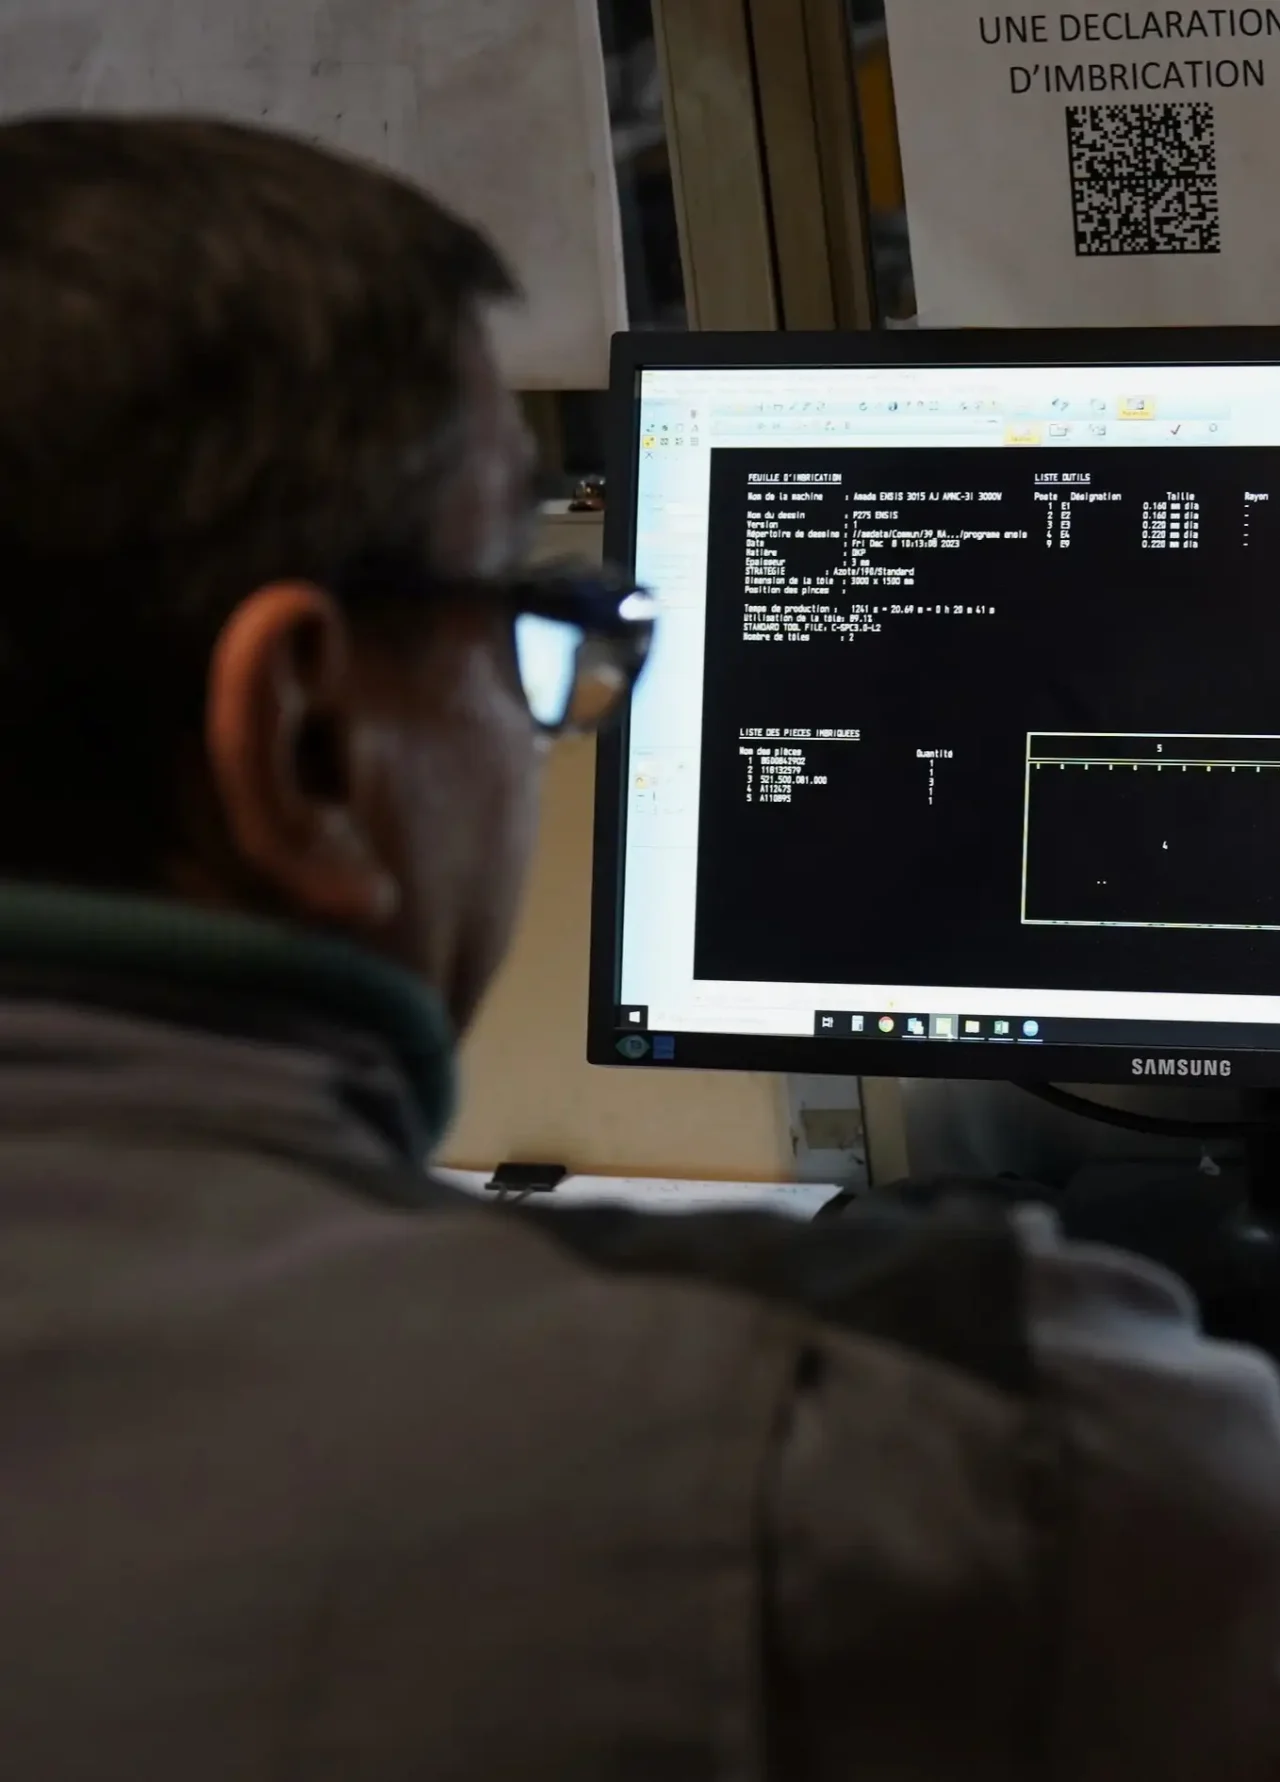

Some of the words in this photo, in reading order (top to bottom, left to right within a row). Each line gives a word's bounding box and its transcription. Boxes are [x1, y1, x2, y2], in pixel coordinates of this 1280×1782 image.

[978, 15, 1048, 45] UNE
[1009, 59, 1265, 94] D'IMBRICATION
[748, 473, 780, 482] FEUILLE
[783, 473, 842, 482] D'IMBRICATION
[1034, 472, 1059, 482] LISTE
[1062, 472, 1091, 482] OUTILS
[747, 492, 762, 501] Nom
[764, 492, 776, 501] de
[779, 492, 788, 501] la
[791, 492, 824, 501] machine
[853, 492, 877, 501] Amada
[879, 491, 904, 501] ENSIS
[906, 491, 926, 501] 3015
[928, 492, 940, 501] AJ
[1034, 491, 1058, 501] Poste
[1166, 491, 1195, 501] Taille
[1244, 491, 1269, 503] Rayon
[1061, 501, 1070, 510] E1
[1142, 501, 1167, 510] 0.160
[746, 510, 762, 520] Nom
[764, 510, 775, 520] du
[777, 510, 806, 520] dessin
[852, 510, 872, 520] P275
[874, 510, 898, 520] ENSIS
[1060, 510, 1072, 520] E2
[1142, 510, 1167, 520] 0.160
[746, 520, 779, 529] Version
[1060, 520, 1071, 530] E3
[1142, 520, 1167, 530] 0.220
[746, 528, 792, 540] Répertoire
[794, 529, 805, 538] de
[807, 529, 840, 539] dessins
[1060, 529, 1070, 539] E4
[1142, 530, 1166, 539] 0.220
[746, 538, 765, 548] Date
[851, 538, 865, 548] Fri
[869, 538, 884, 548] Dec
[940, 539, 960, 548] 2023
[1059, 539, 1070, 548] E9
[1141, 539, 1166, 548] 0.220
[745, 566, 786, 576] STRATEGIE
[744, 576, 786, 585] Dimension
[788, 576, 799, 585] de
[802, 576, 812, 585] la
[850, 576, 870, 585] 3000
[882, 576, 901, 586] 1500
[744, 585, 781, 594] Position
[783, 586, 798, 594] des
[801, 586, 830, 596] pinces
[770, 604, 782, 613] de
[784, 604, 830, 615] production
[743, 613, 794, 622] Utilisation
[796, 614, 807, 623] de
[810, 614, 820, 623] la
[743, 622, 780, 632] STANDARD
[782, 622, 802, 632] TOOL
[804, 623, 827, 632] FILE:
[742, 632, 771, 641] Nombre
[773, 632, 784, 641] de
[739, 727, 763, 737] LISTE
[765, 728, 780, 737] DES
[783, 728, 812, 737] PIECES
[816, 729, 860, 738] IMBRIQUEES
[916, 749, 954, 758] Quantité
[1131, 1058, 1232, 1077] SAMSUNG
